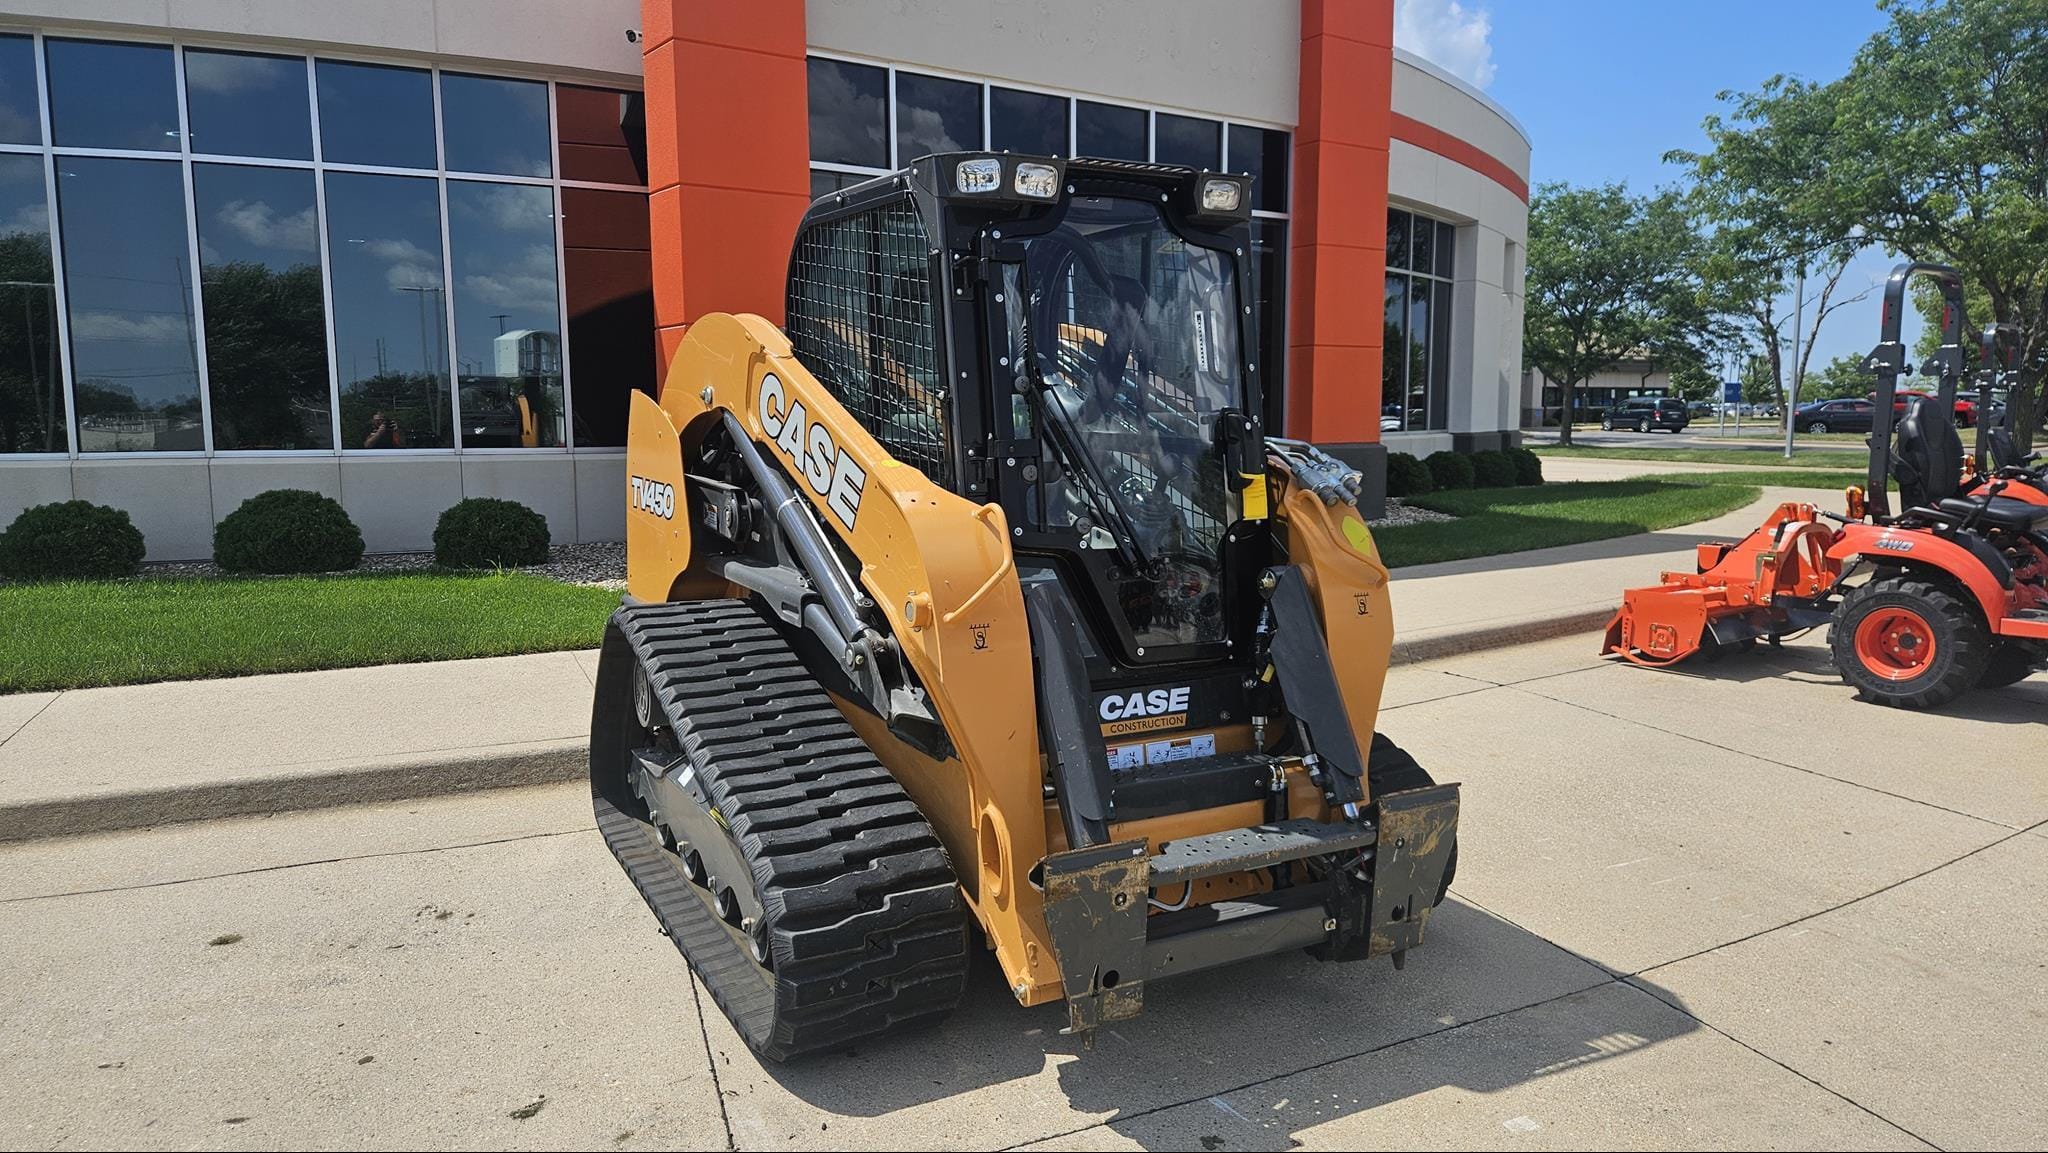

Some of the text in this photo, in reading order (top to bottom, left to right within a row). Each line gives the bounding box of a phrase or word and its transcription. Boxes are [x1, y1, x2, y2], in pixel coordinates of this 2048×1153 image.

[759, 372, 867, 533] CASE
[631, 475, 675, 520] TV450
[1100, 686, 1190, 720] CASE
[1110, 715, 1184, 734] CONSTRUCTION
